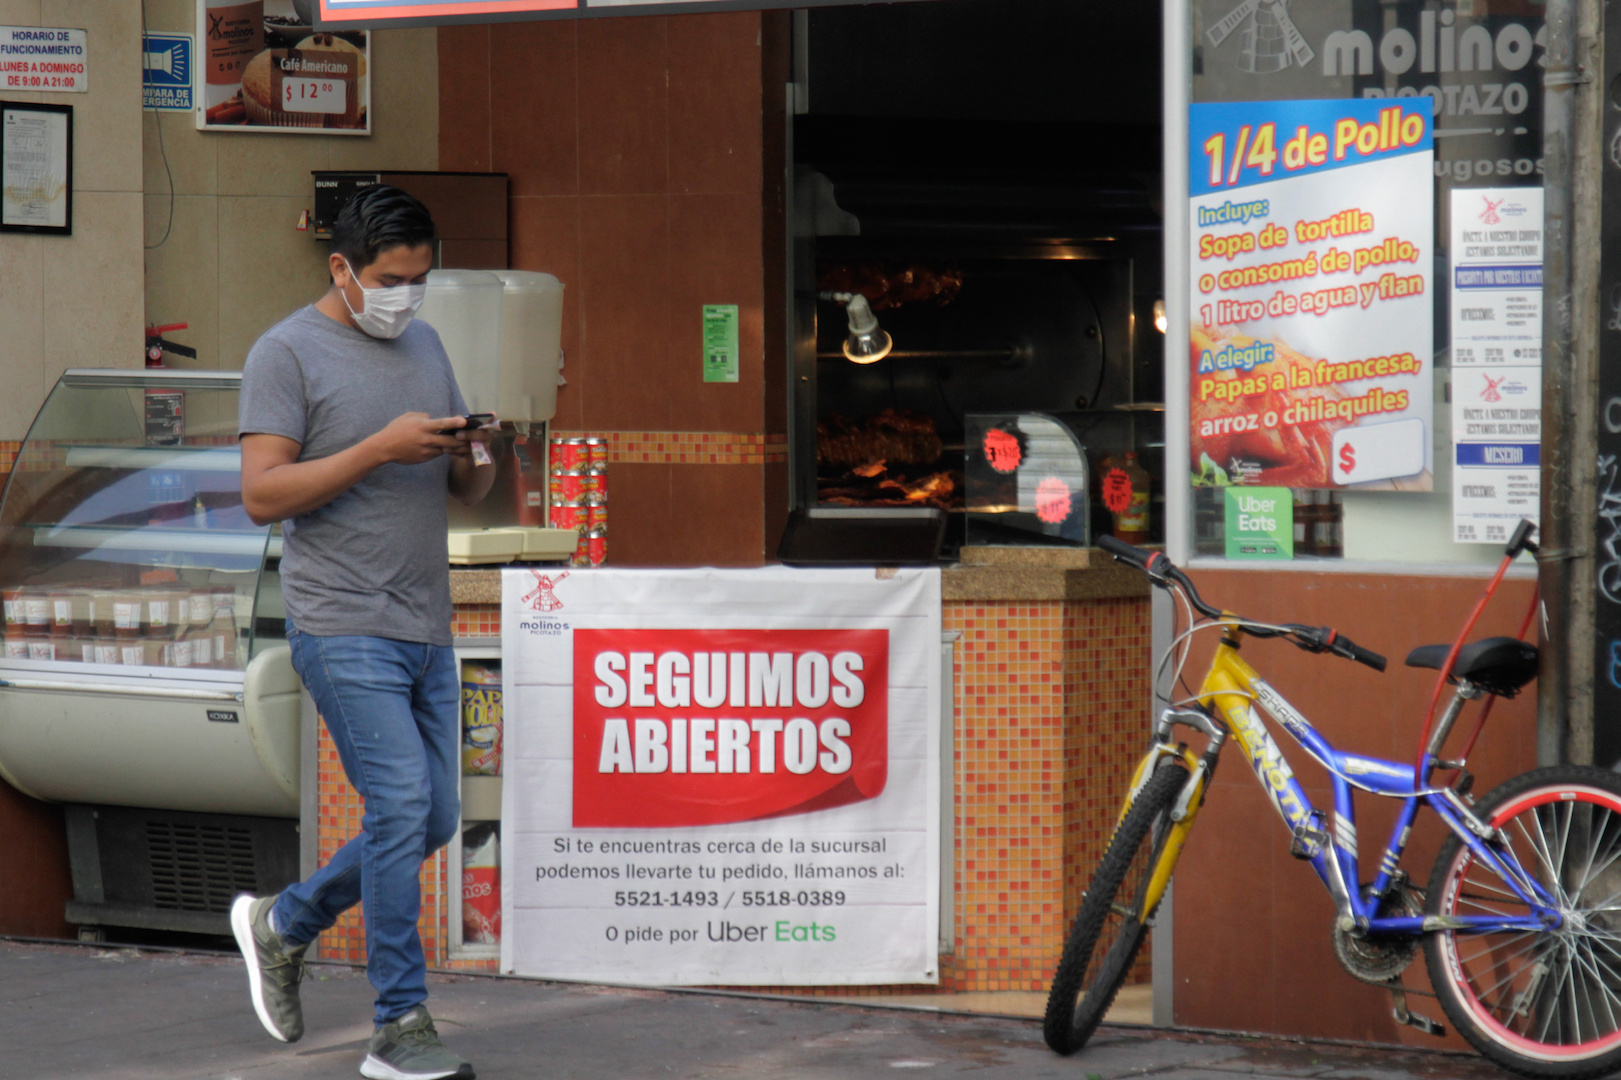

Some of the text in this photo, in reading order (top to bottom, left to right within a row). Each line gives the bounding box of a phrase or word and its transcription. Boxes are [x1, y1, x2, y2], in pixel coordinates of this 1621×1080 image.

[12, 31, 69, 41] HORARIO DE
[1, 44, 83, 55] FUNCIONAMIENTO
[0, 61, 84, 74] LUNES A DOMINGO
[280, 57, 349, 74] Café Americano
[8, 75, 75, 87] DE 9:00 A 21:00
[176, 90, 190, 99] DE
[286, 84, 293, 102] $
[1204, 104, 1426, 187] 1/4 de Pollo
[1199, 199, 1270, 228] Incluye:
[1199, 207, 1375, 261] Sopa de tortilla
[1199, 237, 1420, 294] o consomé de pollo,
[1200, 272, 1424, 328] 1 litro de agua y flan
[1199, 340, 1275, 375] A elegir:
[1200, 372, 1268, 404] Papas
[1272, 372, 1287, 392] a
[1291, 363, 1312, 389] la
[1316, 351, 1423, 386] francesa,
[1200, 387, 1410, 439] arroz o chilaquiles
[1338, 443, 1356, 475] $
[1239, 496, 1278, 513] Uber
[1238, 513, 1278, 532] Eats
[520, 620, 570, 631] molinos
[594, 650, 866, 709] SEGUIMOS
[1258, 688, 1310, 738] SHARK
[598, 716, 854, 776] ABIERTOS
[553, 837, 887, 855] Si te encuentras cerca de la sucursal
[535, 863, 905, 882] podemos llevarte tu pedido, llámanos al:
[613, 890, 846, 910] 5521-1493 / 5518-0389
[605, 920, 837, 944] O pide por Uber Eats
